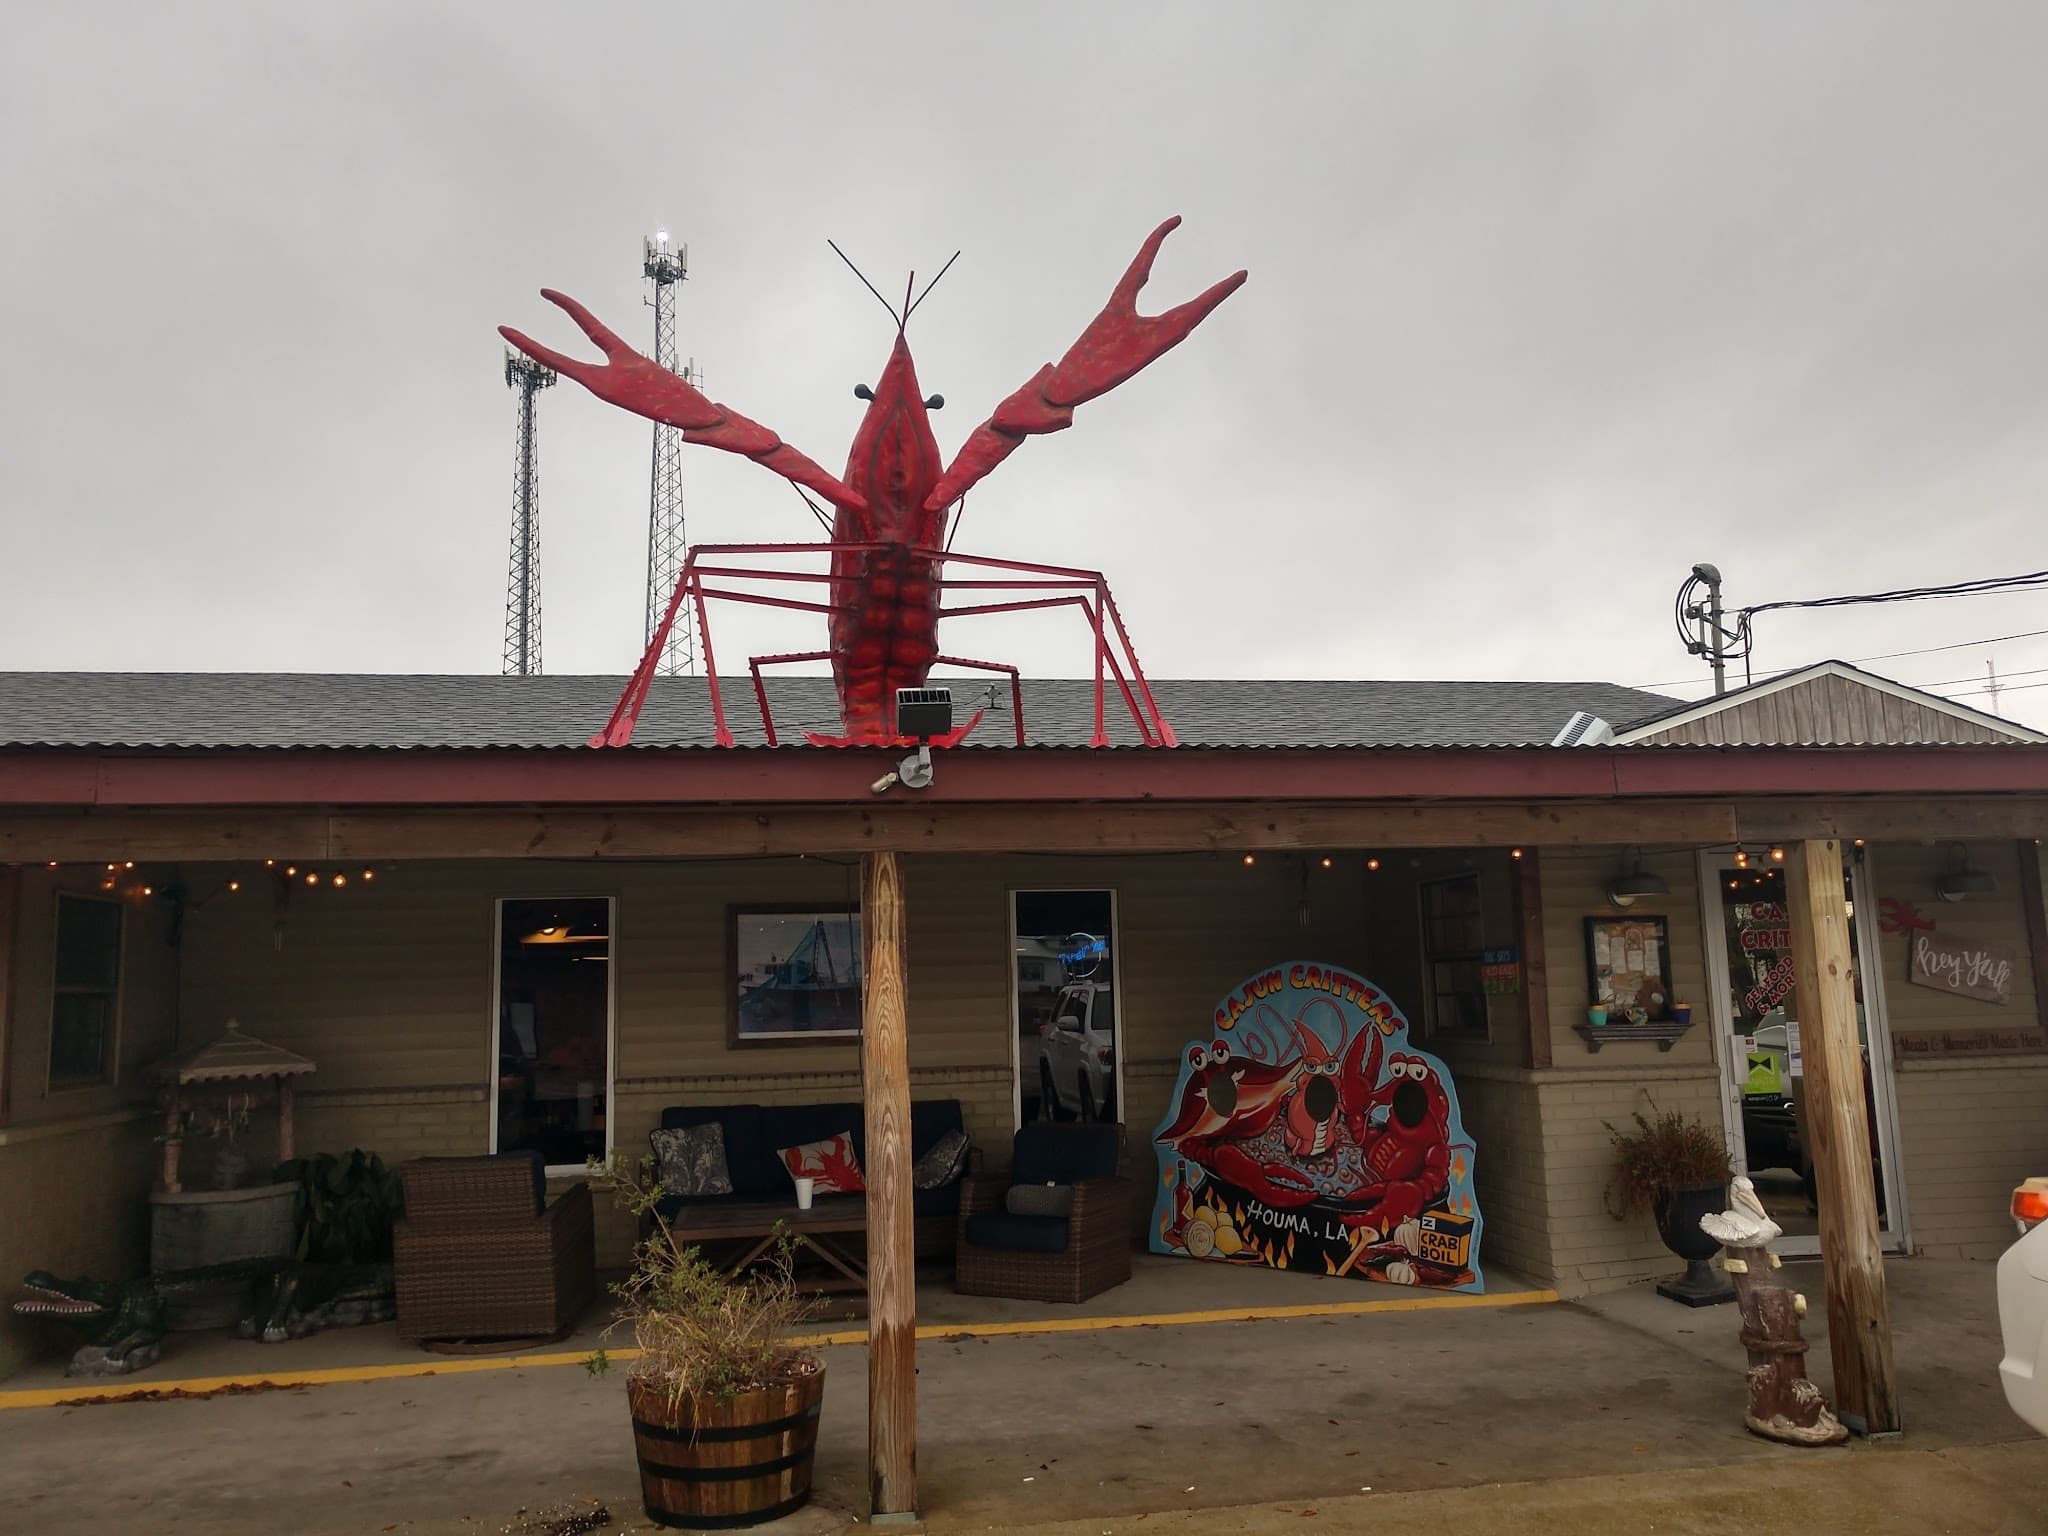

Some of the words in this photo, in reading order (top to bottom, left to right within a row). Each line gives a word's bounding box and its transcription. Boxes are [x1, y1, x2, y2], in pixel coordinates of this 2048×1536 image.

[1751, 900, 1788, 921] CA
[1916, 936, 1960, 987] hey
[1744, 955, 1793, 1010] SEAFOOD
[1757, 1001, 1771, 1015] &
[1768, 974, 1796, 1005] MOR
[1216, 970, 1283, 1031] CAJUN
[1289, 964, 1405, 1036] CRITTERS
[1325, 1221, 1349, 1243] LA
[1421, 1233, 1458, 1250] CRAB
[1421, 1245, 1455, 1263] BOIL
